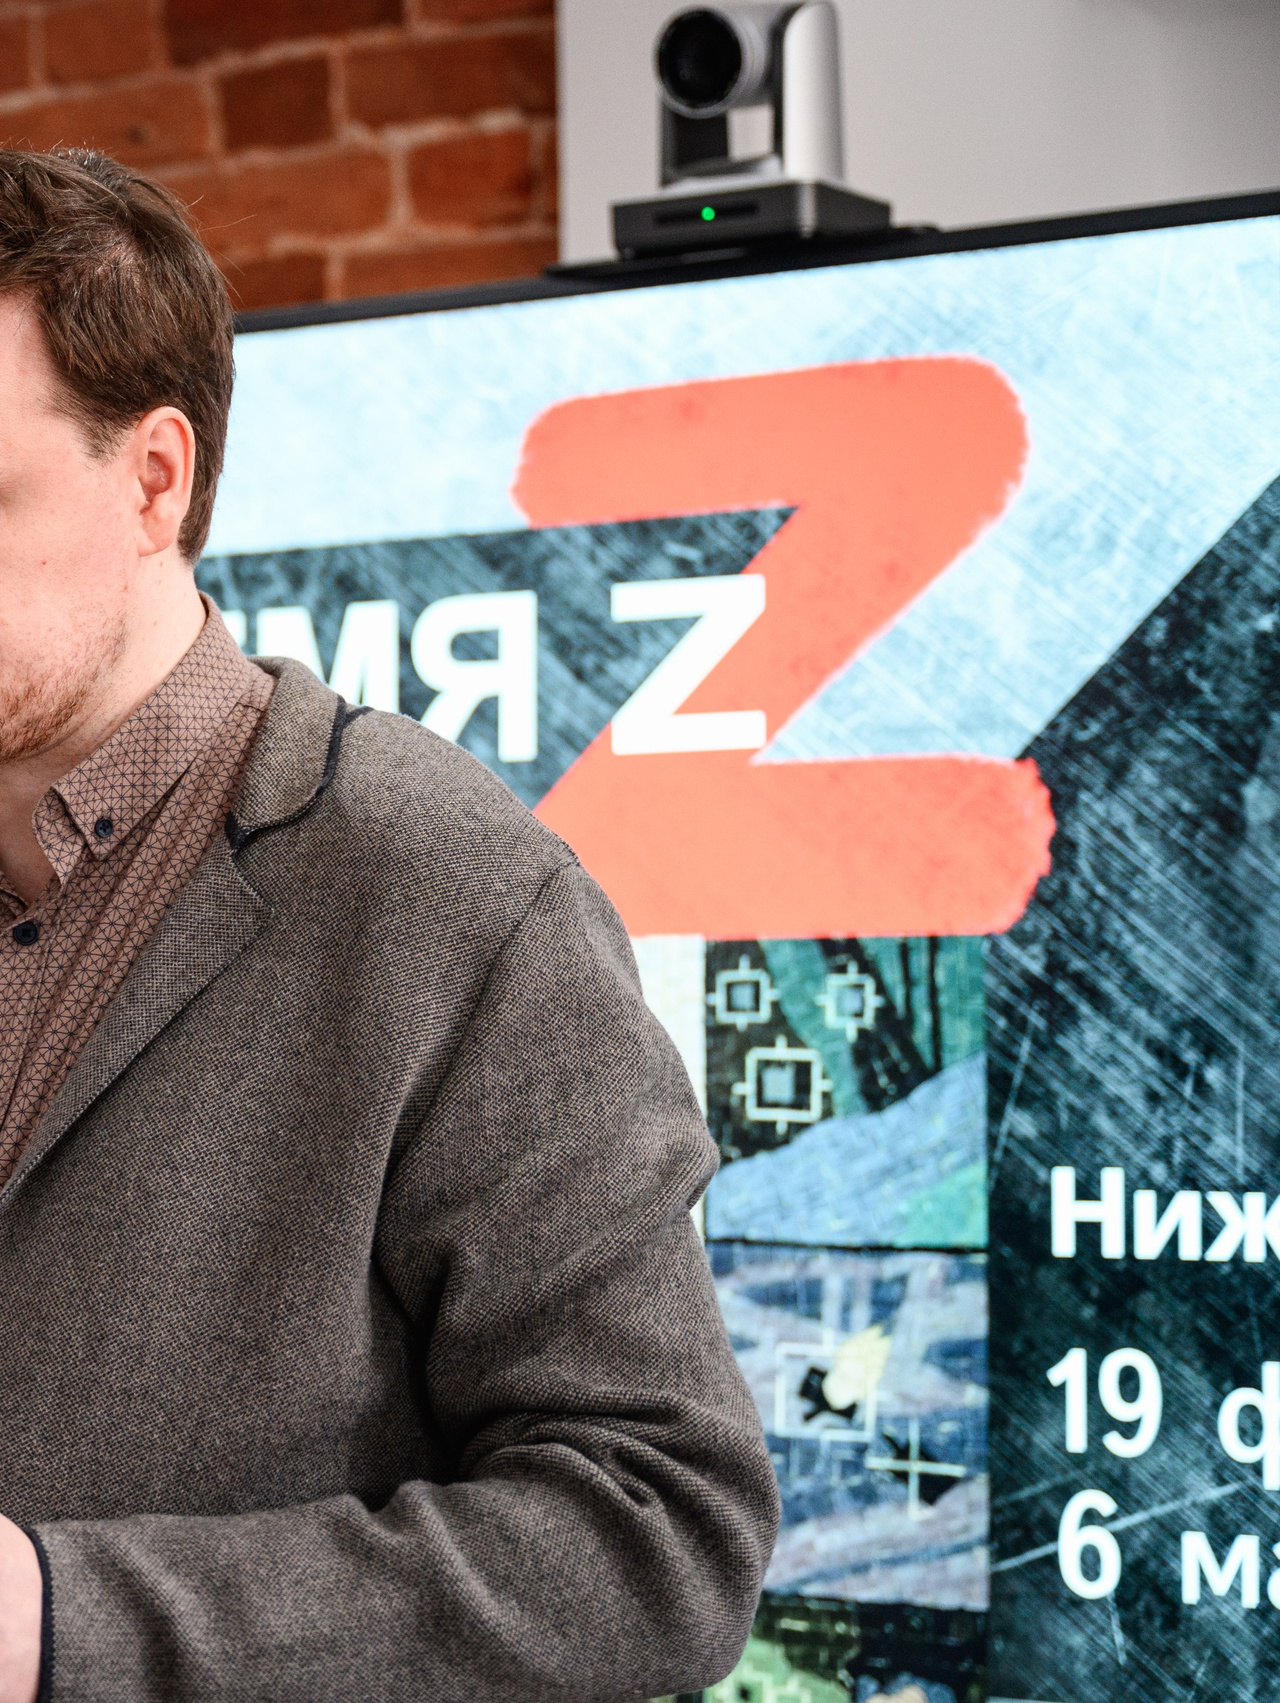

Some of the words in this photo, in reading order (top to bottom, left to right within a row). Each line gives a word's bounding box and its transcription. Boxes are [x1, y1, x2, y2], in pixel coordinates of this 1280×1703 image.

[220, 588, 540, 764] МЯ
[609, 572, 767, 756] Z
[1049, 1164, 1280, 1264] Ниж
[1045, 1346, 1164, 1459] 19
[1056, 1488, 1122, 1600] 6
[1180, 1530, 1280, 1610] м
